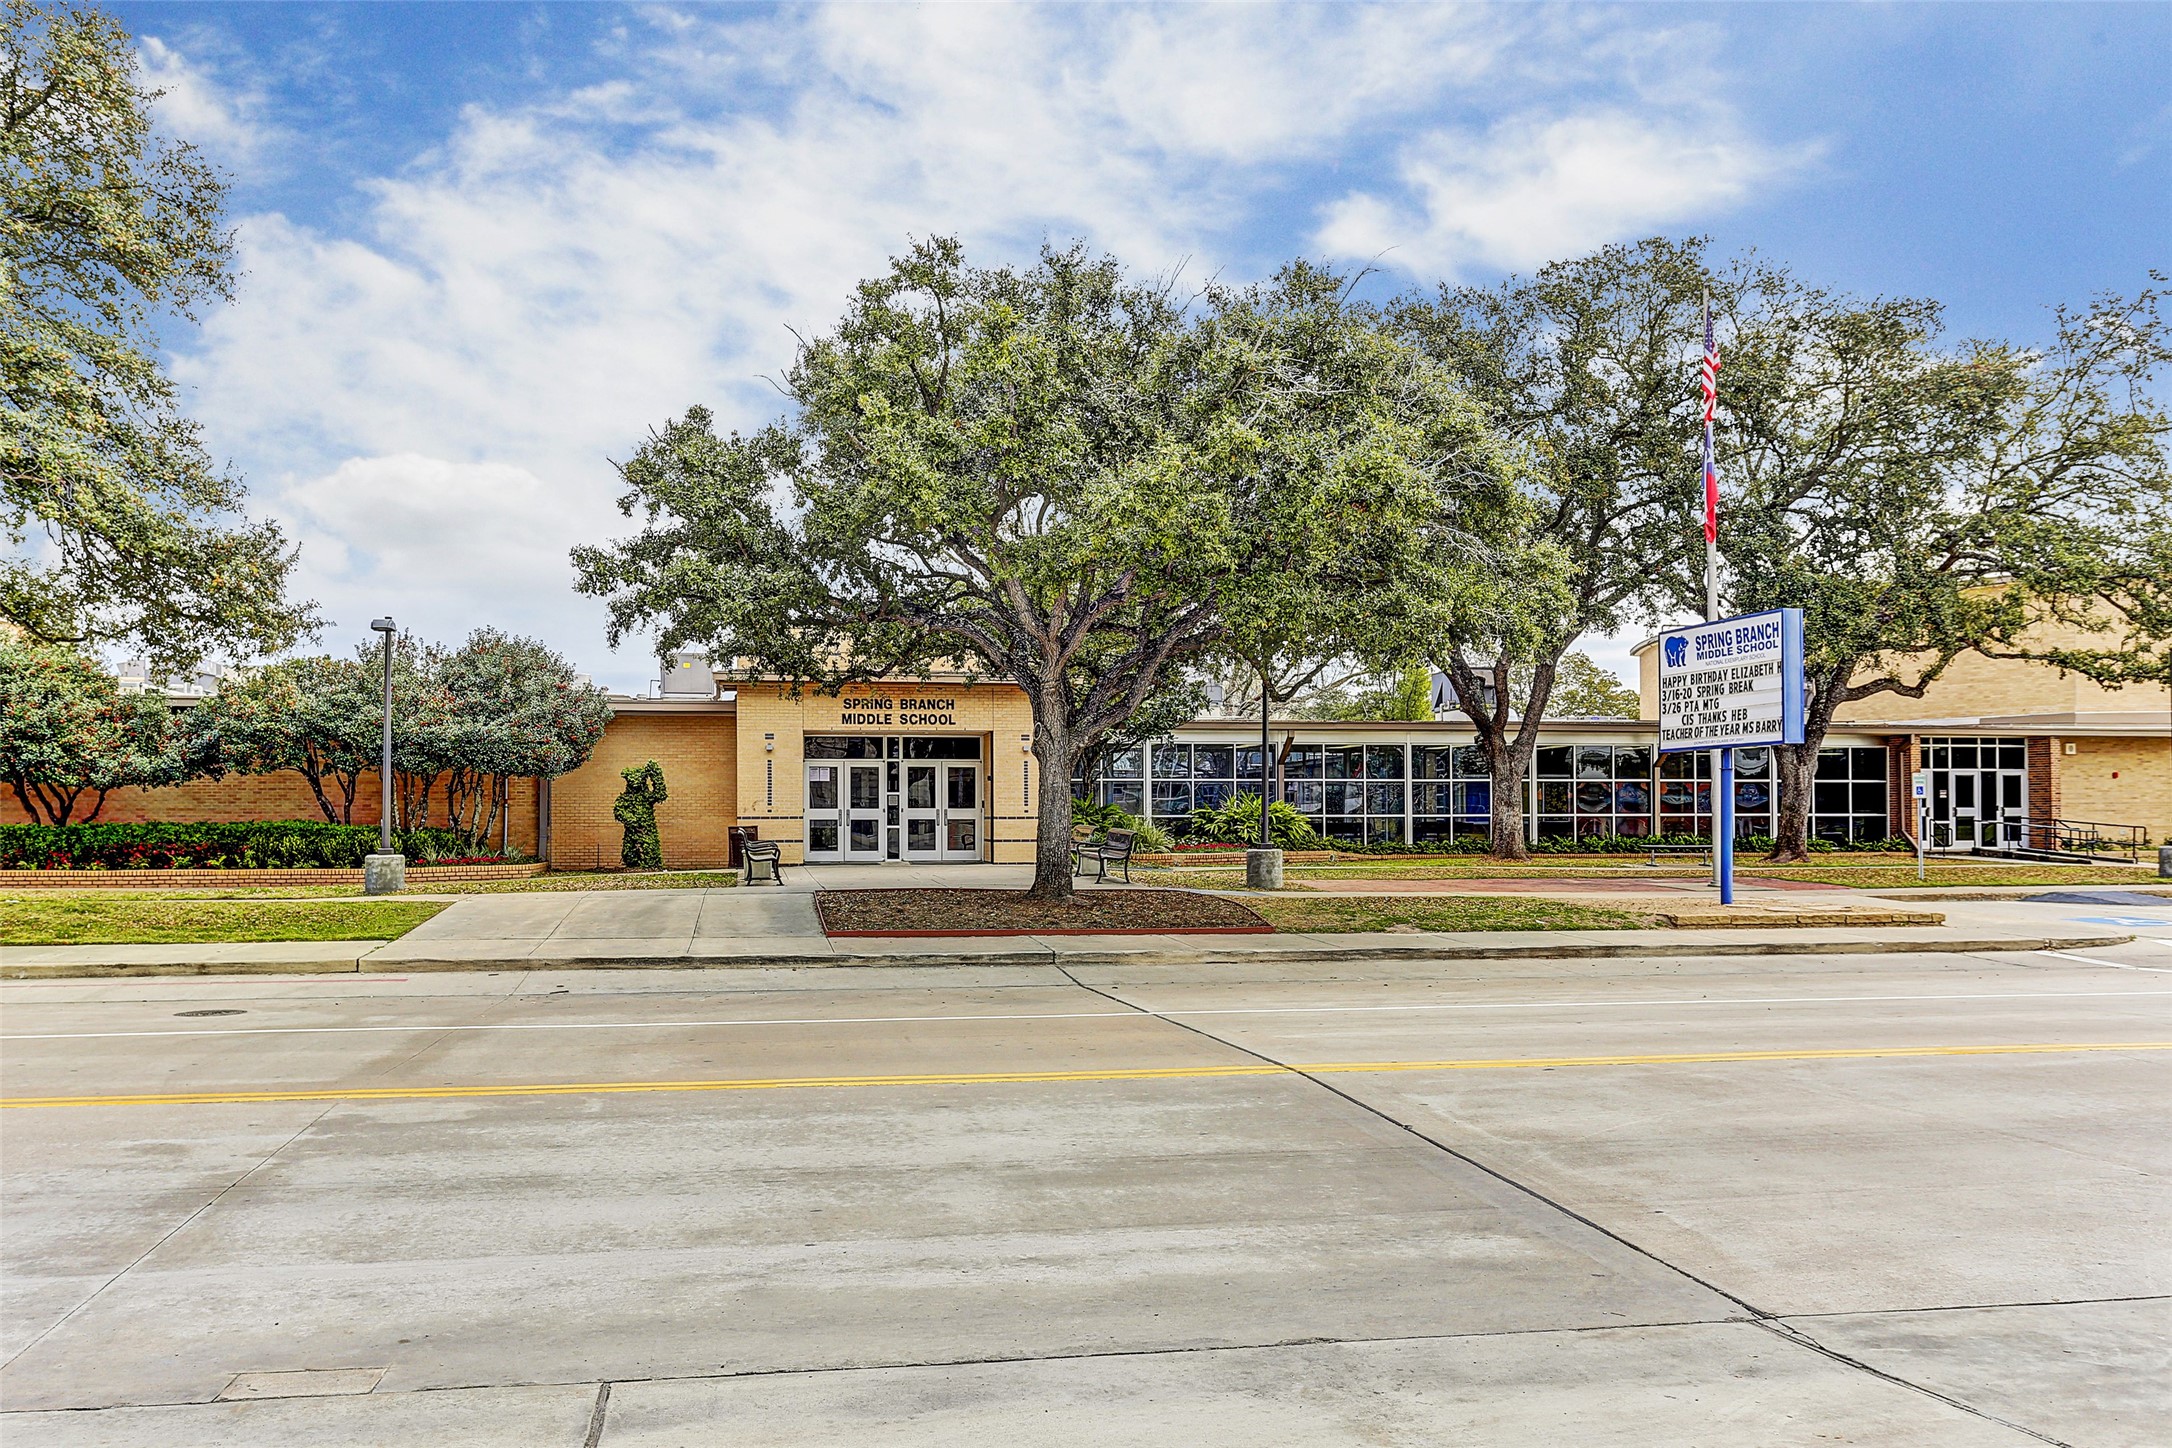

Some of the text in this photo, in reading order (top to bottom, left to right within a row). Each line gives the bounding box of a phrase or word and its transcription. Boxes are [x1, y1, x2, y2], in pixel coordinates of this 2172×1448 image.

[1695, 621, 1779, 651] SPRING BRANCH
[1696, 640, 1778, 660] MIDDLE SCHOOL
[1662, 675, 1687, 689] HAPPY
[1690, 669, 1728, 686] BIRTHDAY
[1731, 662, 1773, 680] ELIZABETH
[1662, 680, 1754, 701] 3/16-20 SPRING BREAK
[843, 698, 954, 710] SPRING BRANCH
[1662, 698, 1719, 714] 3/26 PTA MTG
[841, 713, 956, 725] MIDDLE SCHOOL
[1681, 708, 1748, 726] CIS THANKS HEB
[1662, 719, 1782, 740] TEACHER OF THE YEAR MS BARRY
